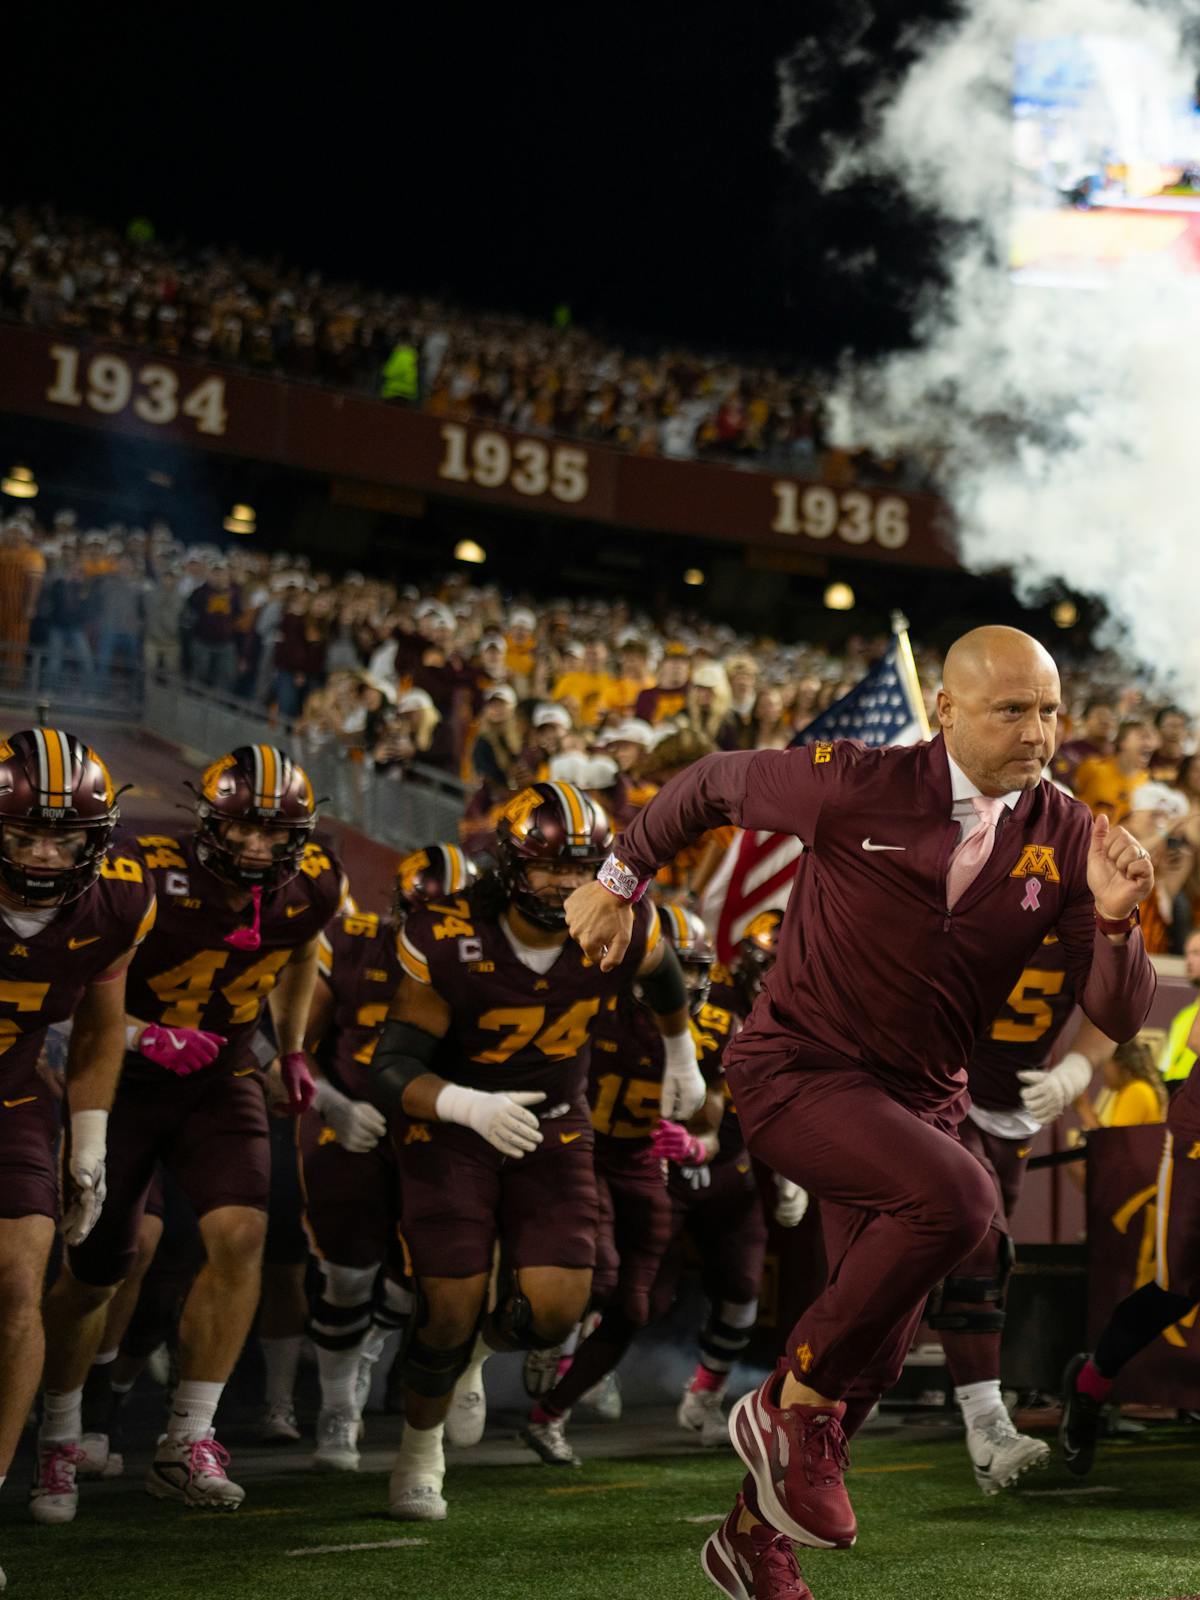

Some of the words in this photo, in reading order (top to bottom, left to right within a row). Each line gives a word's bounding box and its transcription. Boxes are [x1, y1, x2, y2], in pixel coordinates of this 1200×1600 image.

[47, 345, 228, 435] 1934
[438, 423, 589, 503] 1935
[772, 480, 909, 549] 1936
[42, 809, 65, 819] ROW
[165, 873, 189, 896] C
[1009, 844, 1061, 883] M
[459, 938, 483, 962] C
[147, 950, 293, 1028] 44
[469, 998, 600, 1065] 74
